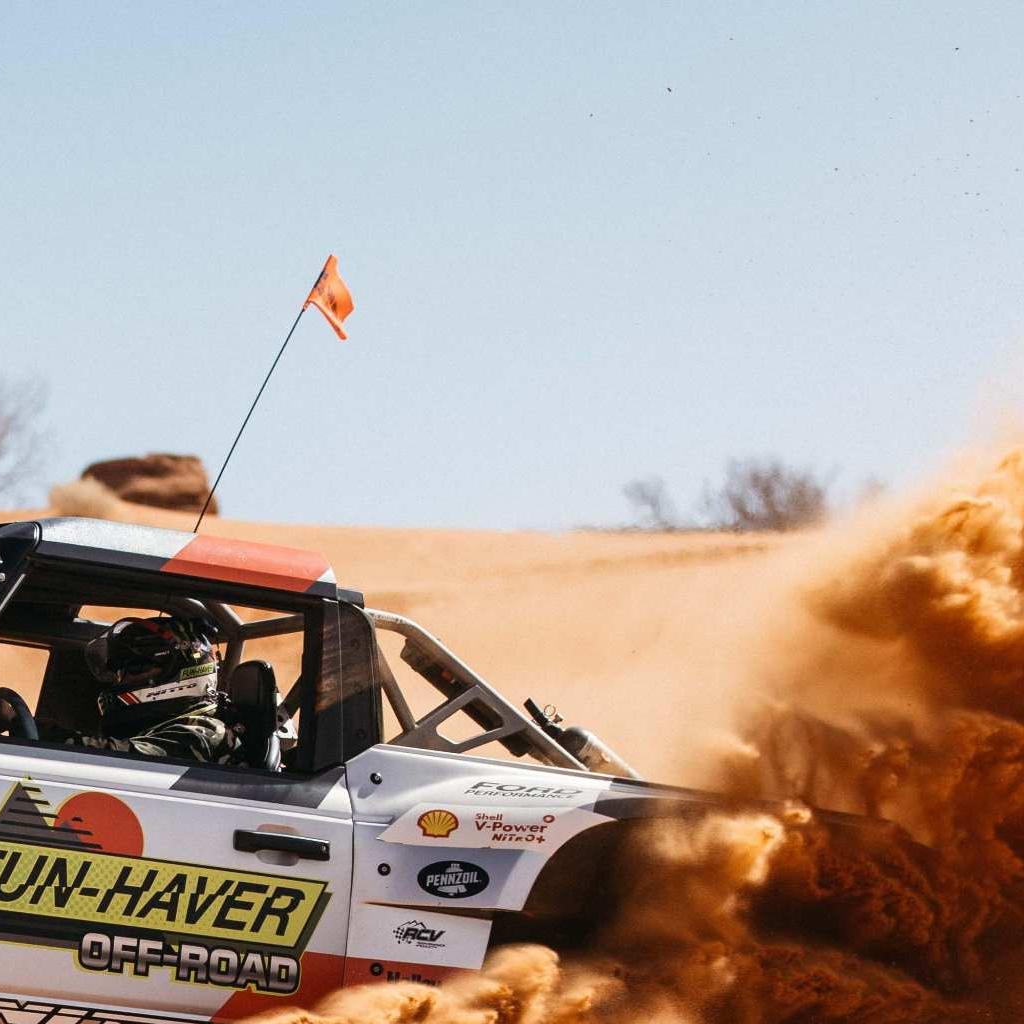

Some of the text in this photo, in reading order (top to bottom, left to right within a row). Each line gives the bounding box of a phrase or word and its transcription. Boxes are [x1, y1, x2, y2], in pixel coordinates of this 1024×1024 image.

[464, 789, 576, 799] PERFORMANCE
[471, 781, 584, 795] FORD
[474, 813, 503, 821] Shell
[475, 820, 548, 833] V-Power
[426, 871, 479, 887] PENNZOIL
[79, 931, 300, 993] OFF-ROAD
